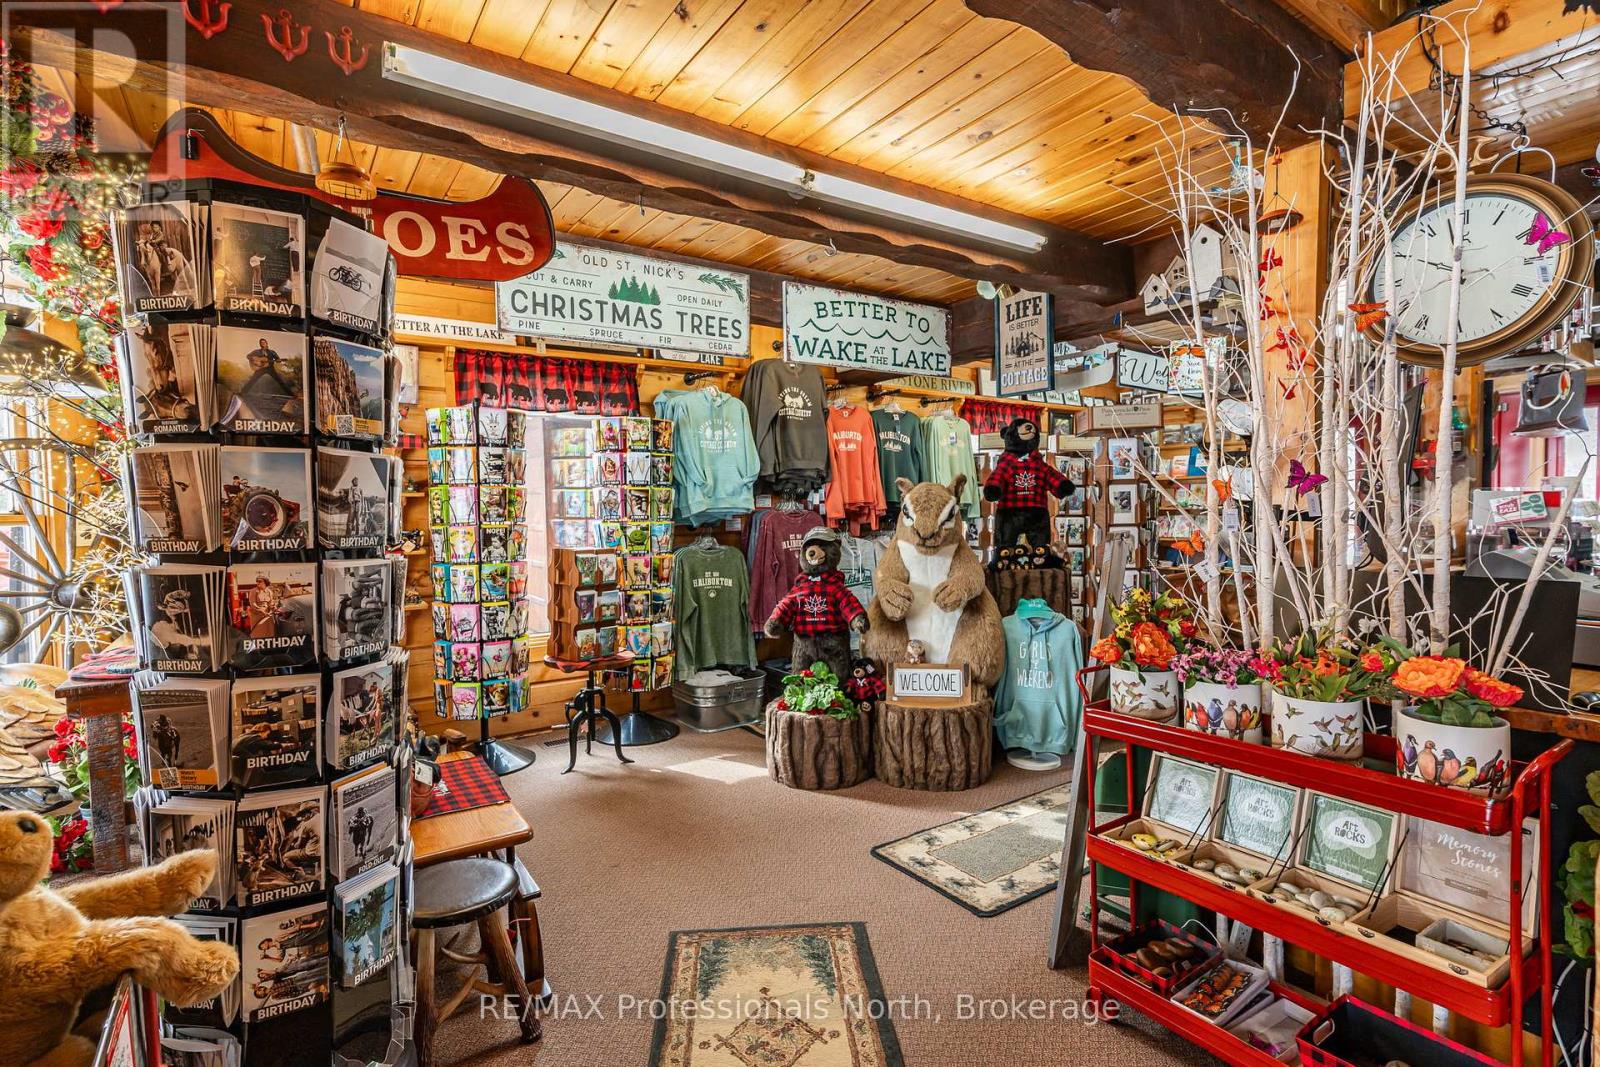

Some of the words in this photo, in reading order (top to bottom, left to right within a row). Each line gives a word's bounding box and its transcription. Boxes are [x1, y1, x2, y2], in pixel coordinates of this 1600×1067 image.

[382, 209, 534, 266] OES
[583, 254, 609, 269] OLD
[616, 260, 635, 273] ST.
[643, 264, 685, 280] NICK'S
[526, 272, 545, 284] CUT
[550, 275, 557, 284] &
[562, 276, 593, 289] CARRY
[140, 297, 187, 311] BIRTHDAY
[229, 299, 295, 317] BIRTHDAY
[677, 293, 697, 304] OPEN
[701, 296, 723, 308] DAILY
[1005, 296, 1043, 323] LIFE
[333, 310, 374, 331] BIRTHDAY
[510, 288, 663, 330] CHRISTMAS
[675, 311, 743, 340] TREES
[813, 300, 898, 323] BETTER
[905, 312, 931, 334] TO
[393, 319, 431, 333] ETTER
[433, 324, 449, 335] AT
[450, 325, 474, 337] THE
[476, 328, 505, 340] LAKE
[1009, 322, 1015, 330] IS
[1016, 318, 1040, 330] BETTER
[518, 319, 541, 331] PINE
[589, 328, 624, 340] SPRUCE
[659, 335, 672, 345] FIR
[708, 342, 733, 352] CEDAR
[700, 354, 721, 365] LAKE
[792, 335, 868, 363] WAKE
[892, 347, 948, 372] LAKE
[873, 346, 885, 355] AT
[870, 355, 889, 366] THE
[1013, 360, 1021, 369] AT
[1021, 358, 1034, 368] THE
[896, 375, 938, 389] STONE
[940, 379, 972, 392] RIVER
[1001, 367, 1048, 387] COTTAGE
[153, 424, 189, 433] ROMANTIC
[235, 420, 295, 433] BIRTHDAY
[151, 540, 199, 552] BIRTHDAY
[237, 538, 300, 551] BIRTHDAY
[340, 536, 379, 547] BIRTHDAY
[692, 577, 733, 587] HALIBURTON
[243, 635, 306, 651] BIRTHDAY
[344, 641, 385, 658] BIRTHDAY
[1019, 641, 1052, 661] GRLS
[157, 660, 202, 671] BIRTHDAY
[899, 672, 958, 692] WELCOME
[1016, 667, 1053, 689] WEEKEND
[247, 751, 310, 769] BIRTHDAY
[350, 744, 388, 766] BIRTHDAY
[1334, 826, 1366, 844] ROCKS
[1437, 832, 1499, 863] Memory
[1451, 850, 1502, 878] Stones
[252, 881, 315, 905] BIRTHDAY
[354, 951, 395, 985] BIRTHDAY
[257, 995, 316, 1020] BIRTHDAY
